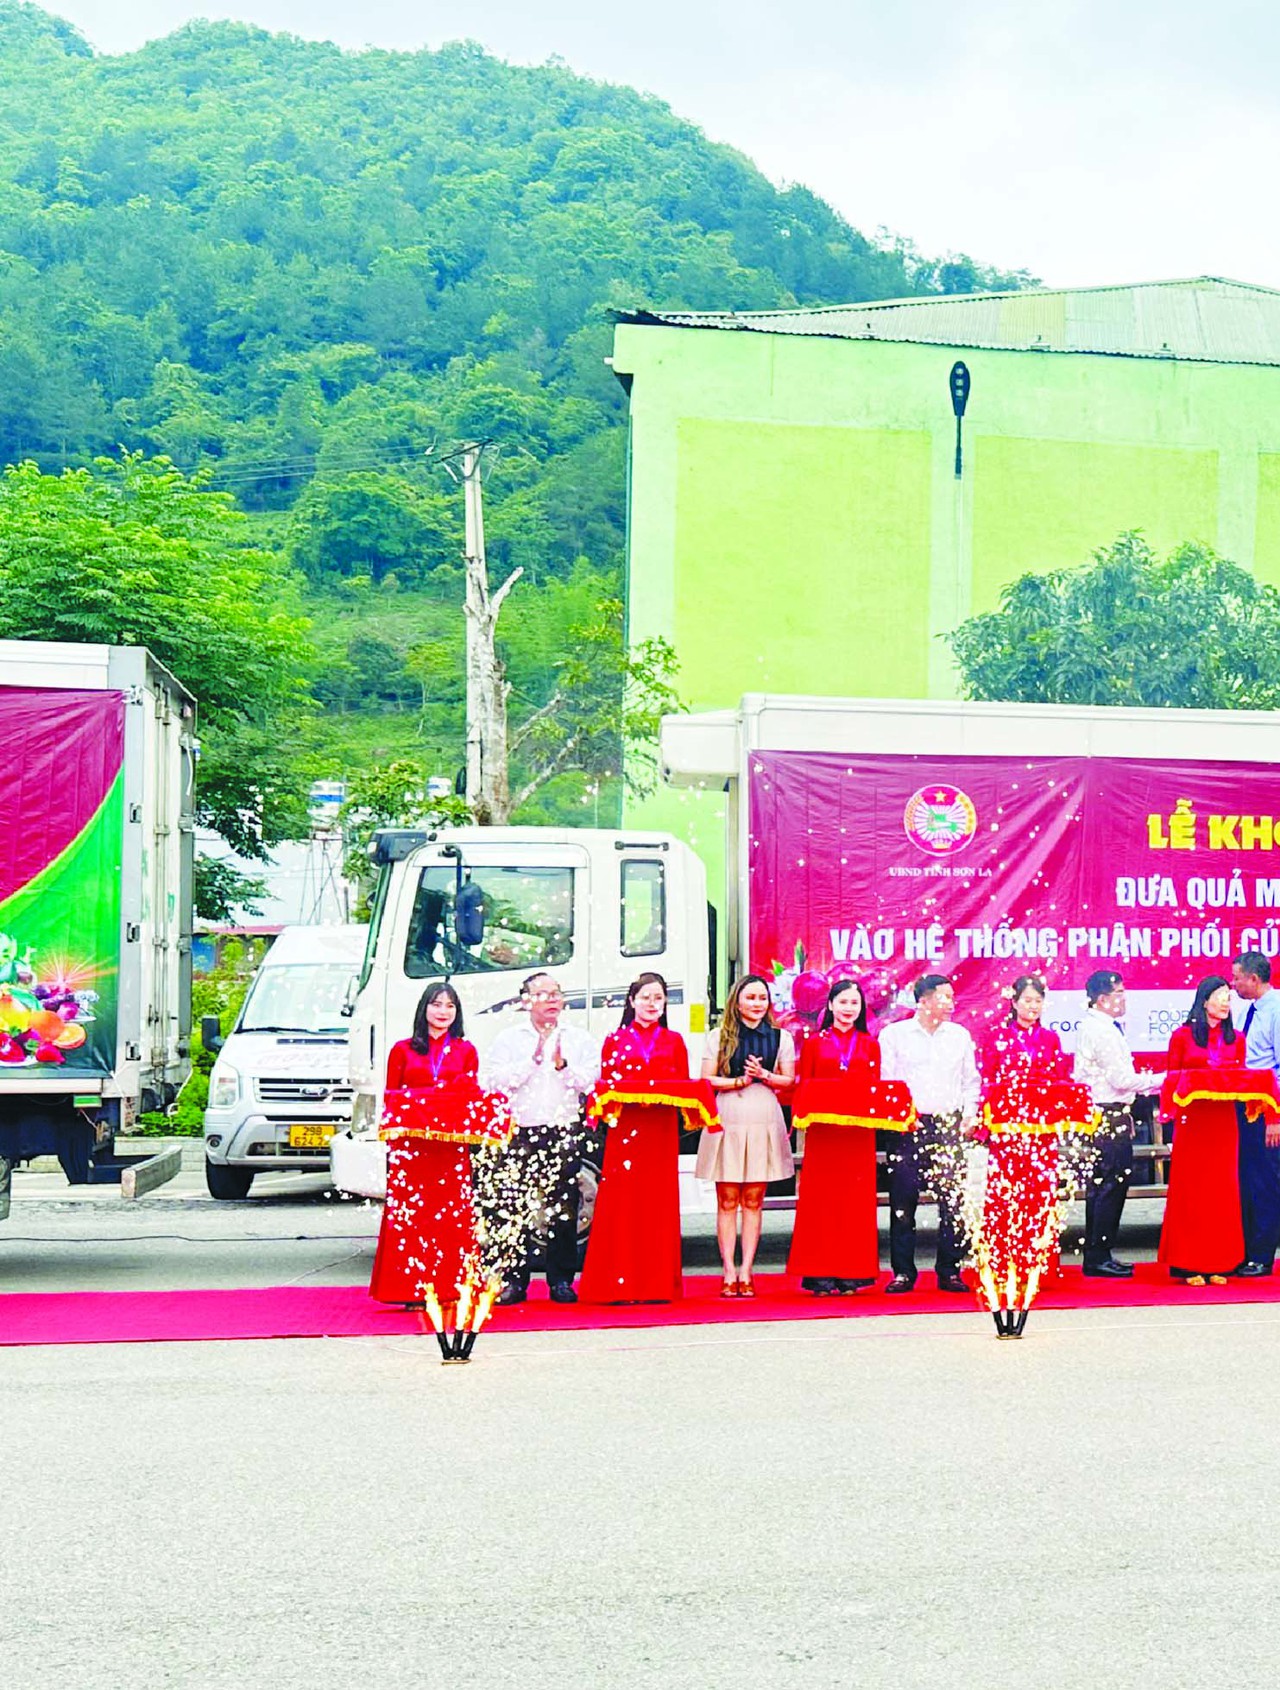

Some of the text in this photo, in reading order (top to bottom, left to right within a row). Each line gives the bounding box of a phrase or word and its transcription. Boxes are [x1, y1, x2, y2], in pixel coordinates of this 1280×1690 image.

[1147, 798, 1197, 849] LỄ
[1117, 874, 1177, 907] ĐƯA
[1187, 868, 1246, 910] QUẢ
[904, 922, 945, 965] HỆ
[954, 918, 1058, 959] THỐNG
[1068, 922, 1151, 957] PHÂN
[1160, 918, 1230, 957] PHỐI
